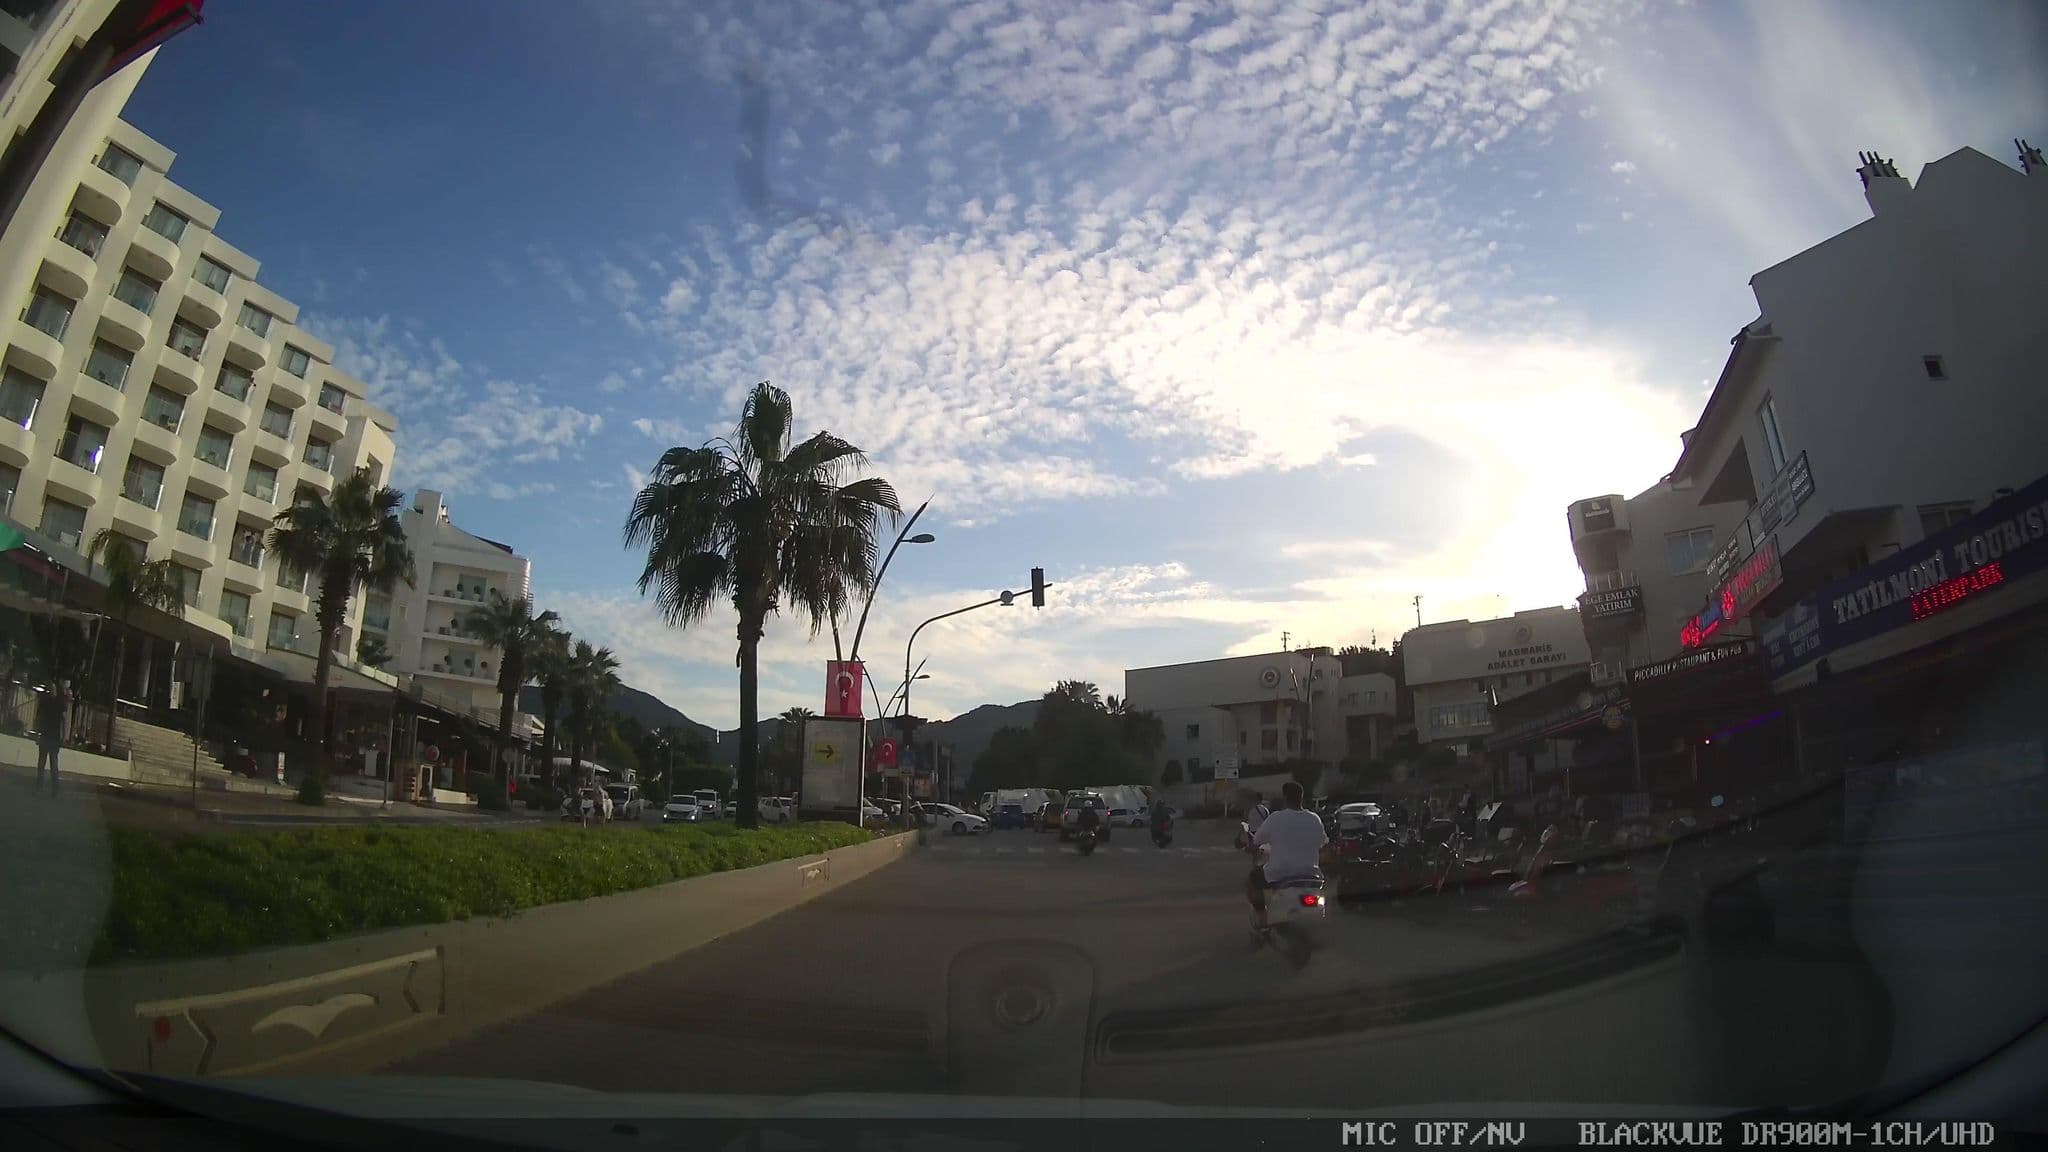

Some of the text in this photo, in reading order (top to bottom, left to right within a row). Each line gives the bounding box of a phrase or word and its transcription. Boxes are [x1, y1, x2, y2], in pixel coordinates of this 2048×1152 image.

[1585, 588, 1638, 606] EGE EMLAK
[1594, 599, 1633, 613] YATIRIM
[1633, 664, 1671, 682] PICCADILLY
[1717, 647, 1730, 659] FUN
